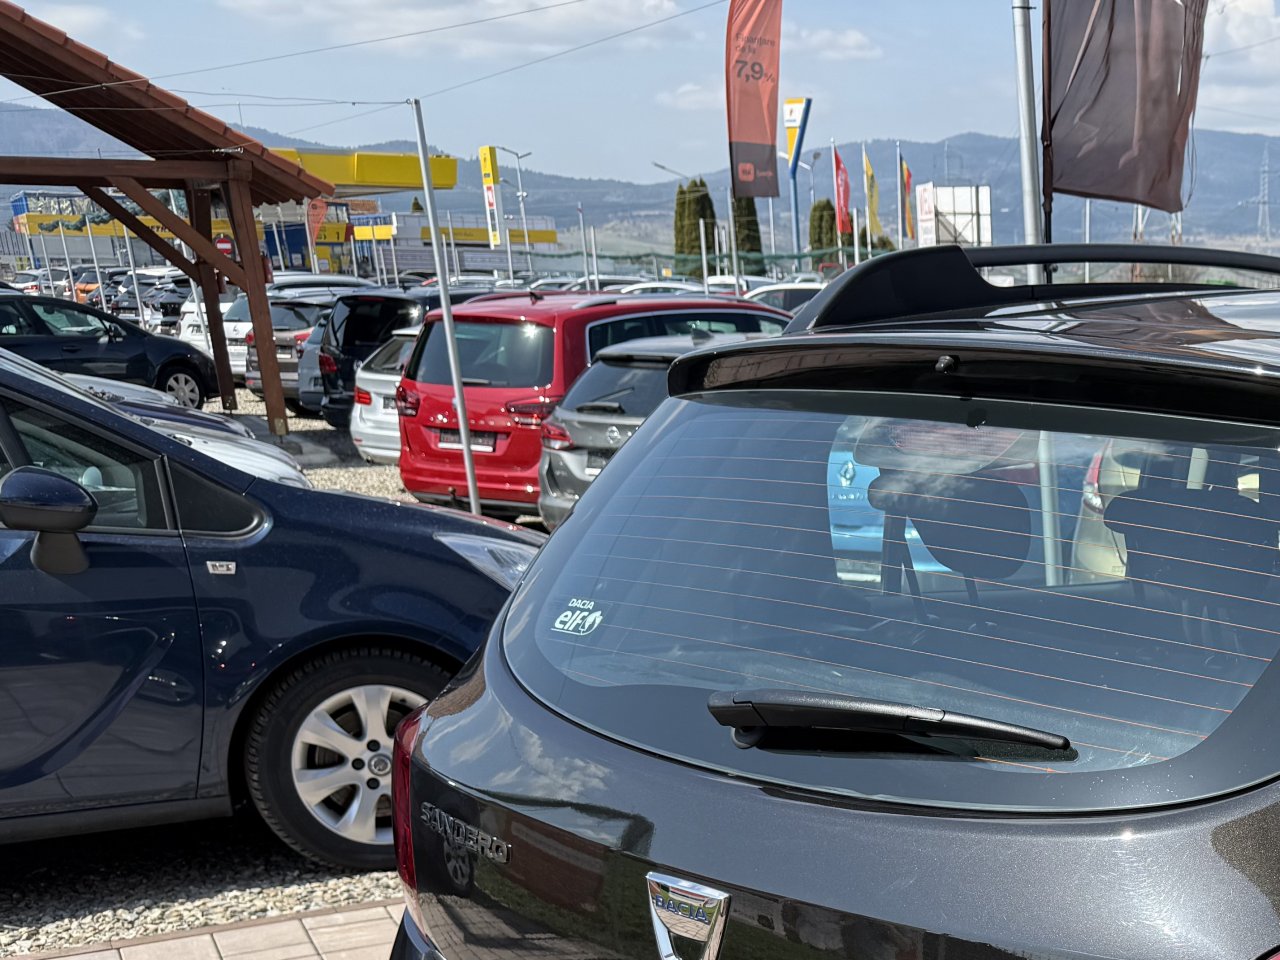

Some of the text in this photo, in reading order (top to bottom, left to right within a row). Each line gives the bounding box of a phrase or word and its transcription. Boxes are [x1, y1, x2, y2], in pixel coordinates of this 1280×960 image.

[568, 598, 595, 610] DACIA
[420, 801, 510, 865] SANDERO
[655, 894, 710, 926] DACIA
